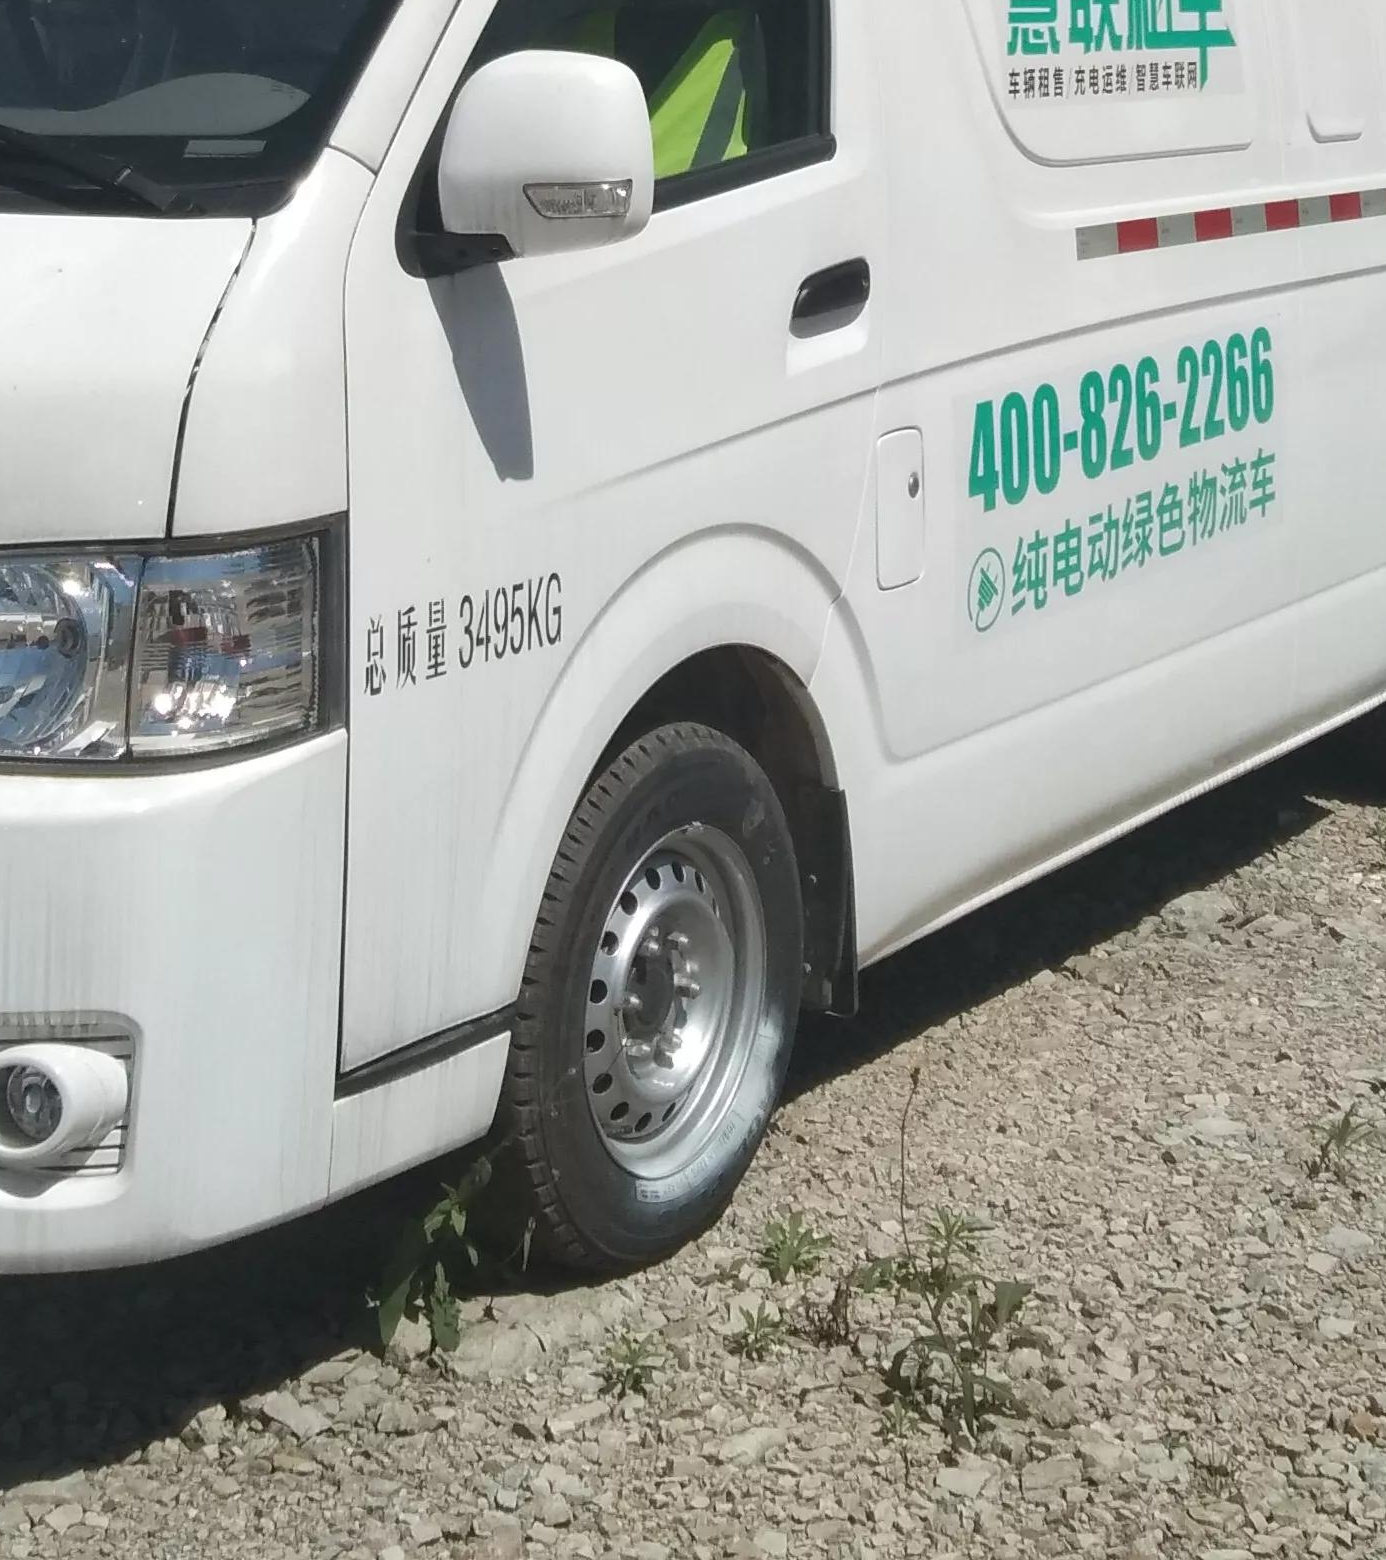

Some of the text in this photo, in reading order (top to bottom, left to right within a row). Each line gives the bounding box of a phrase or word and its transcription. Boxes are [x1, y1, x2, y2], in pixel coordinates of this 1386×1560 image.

[968, 326, 1275, 513] 400-826-2266
[1011, 448, 1276, 616] 纯电动绿色物流车
